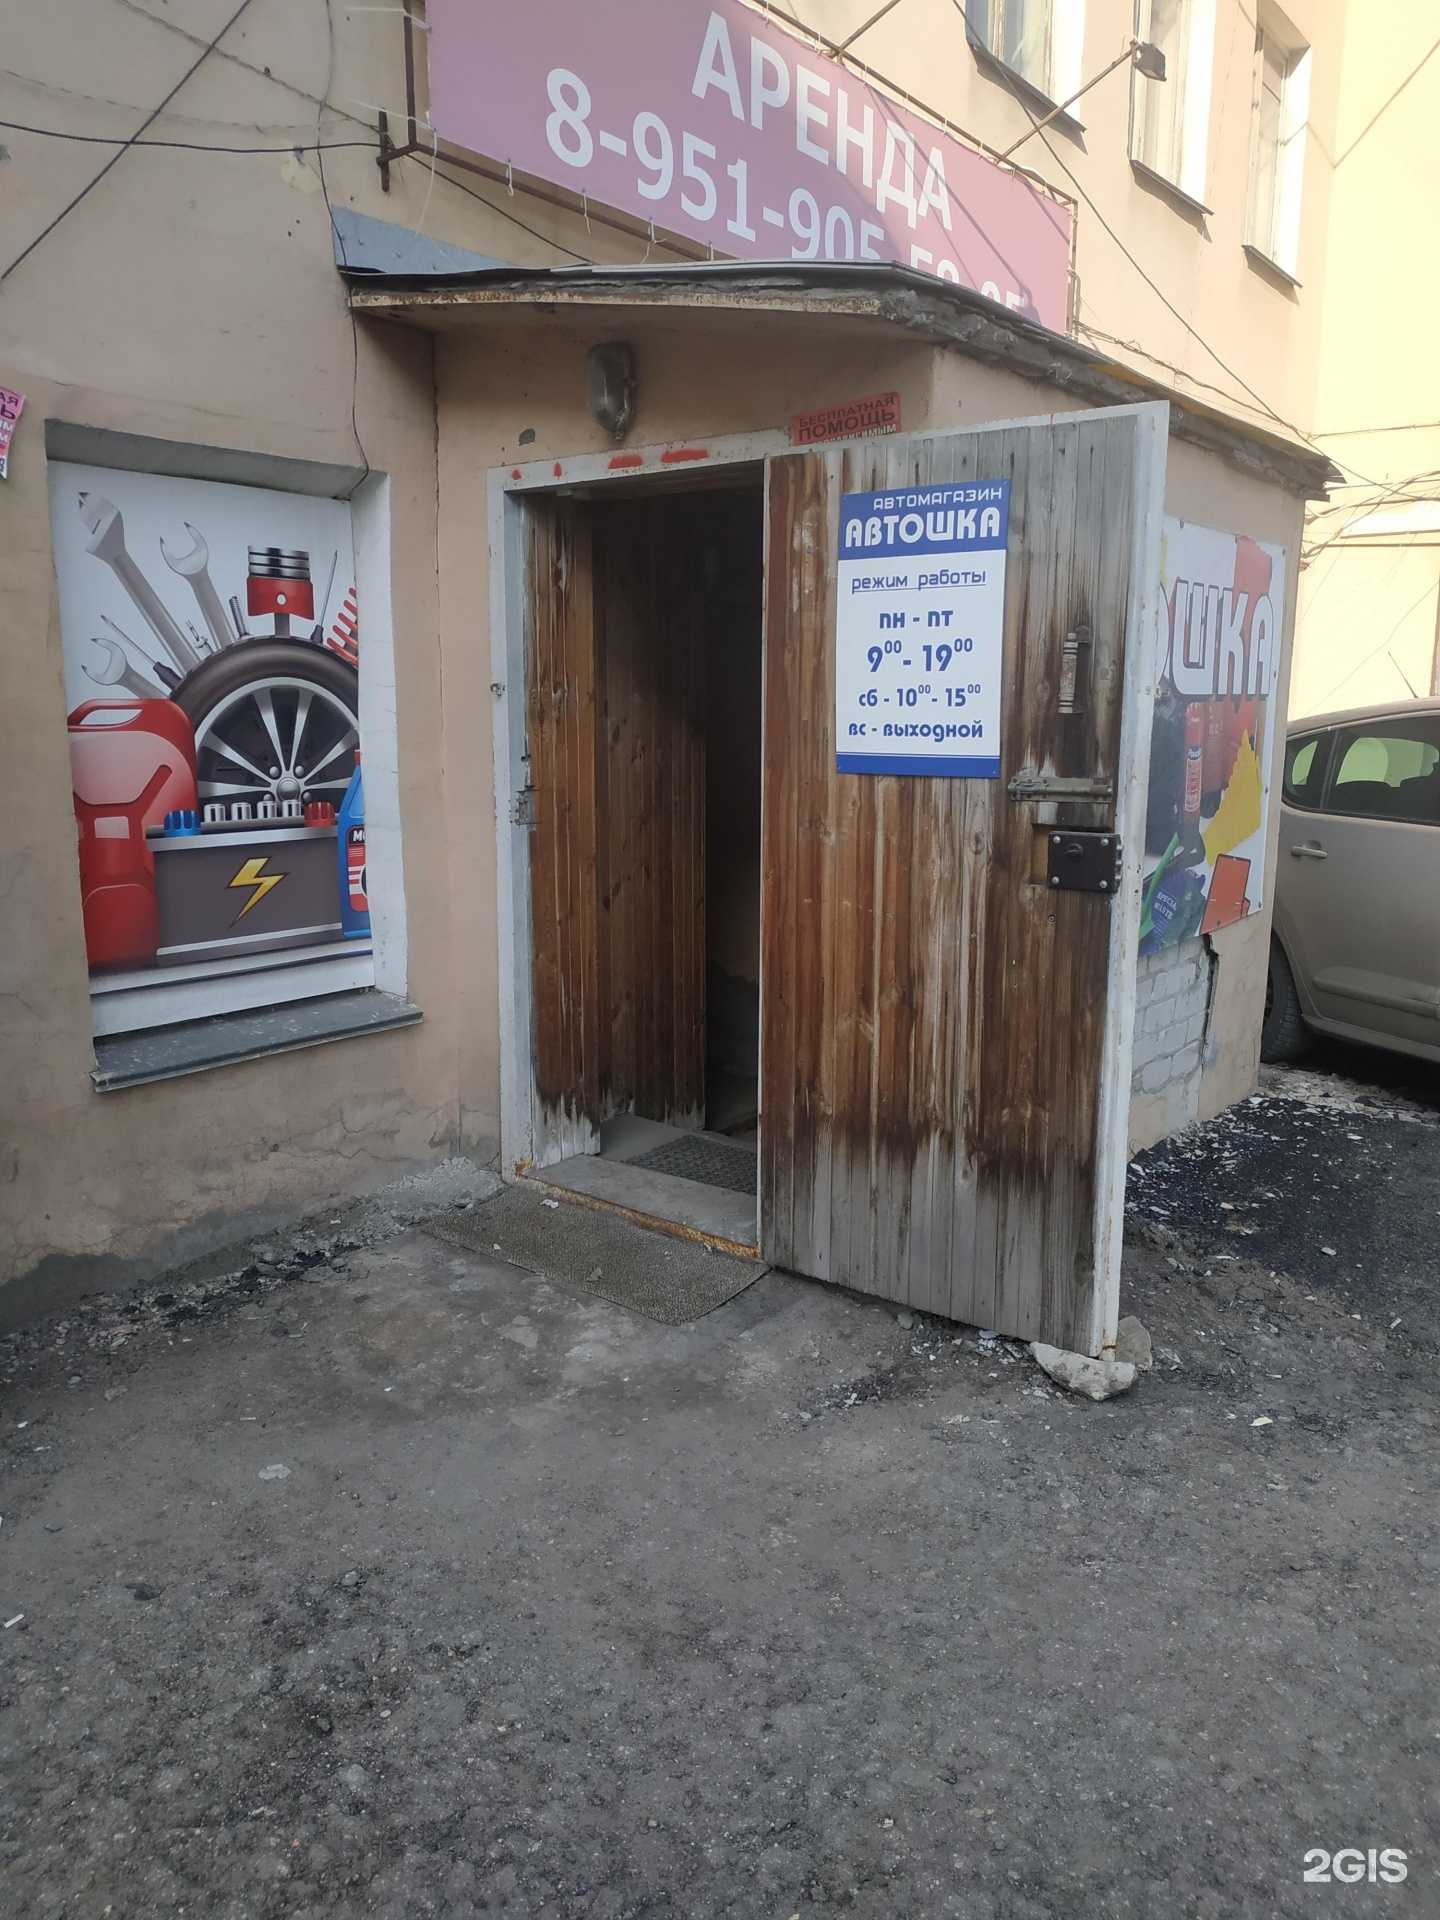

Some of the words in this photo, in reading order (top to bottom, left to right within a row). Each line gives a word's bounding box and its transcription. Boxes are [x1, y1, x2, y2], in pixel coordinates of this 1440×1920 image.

[691, 11, 953, 231] АРЕНДА
[798, 409, 896, 441] ПОМОЩЬ
[873, 487, 1003, 511] АВТОМАГАЗИН
[845, 507, 1001, 548] АВТОШКА
[852, 575, 908, 594] режим
[918, 569, 986, 591] работы
[883, 719, 983, 742] выходной
